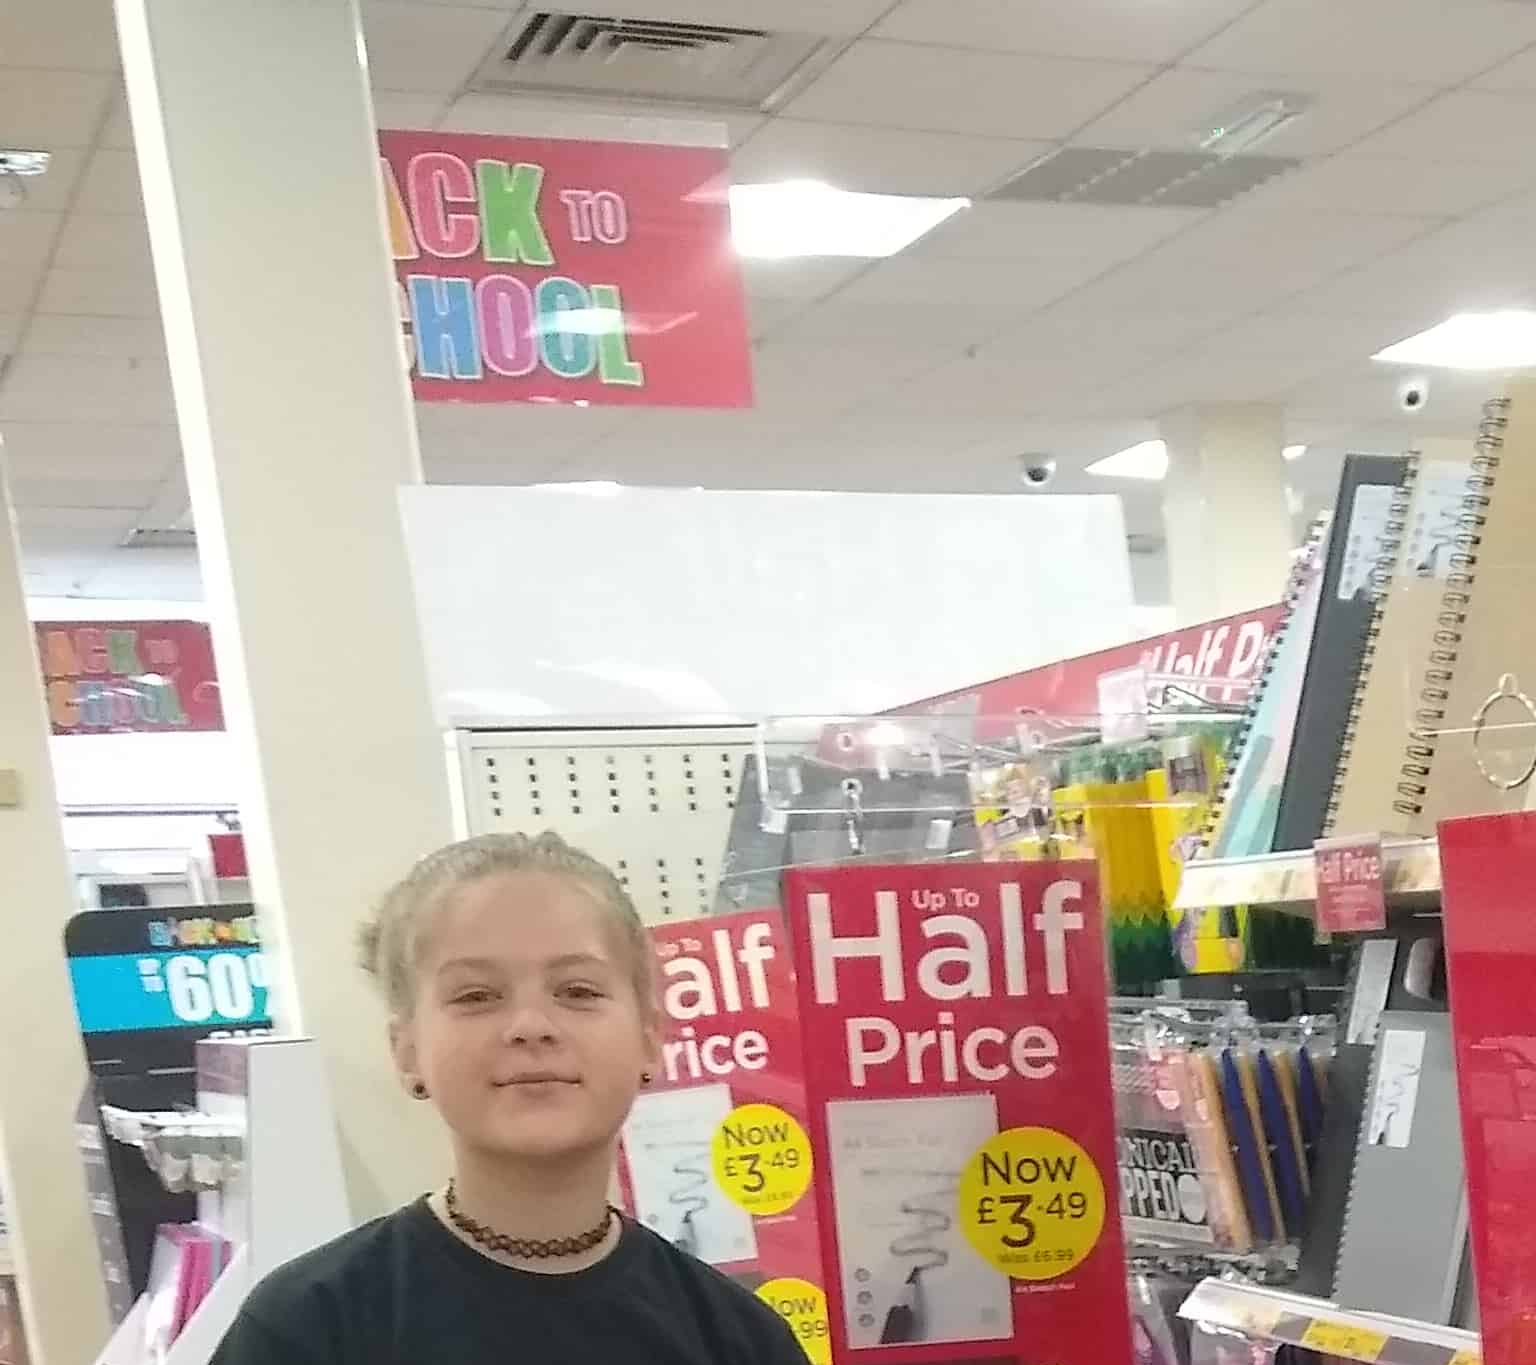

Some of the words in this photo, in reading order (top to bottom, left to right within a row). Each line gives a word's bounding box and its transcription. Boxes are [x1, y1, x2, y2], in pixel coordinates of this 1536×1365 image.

[562, 188, 627, 244] TO
[401, 274, 644, 386] HOOL
[911, 889, 946, 911] Up
[951, 888, 979, 908] To
[663, 923, 775, 1019] alf
[806, 879, 1083, 1004] Half
[661, 1028, 768, 1081] rice
[845, 1012, 1058, 1087] Price
[771, 1297, 816, 1317] ow
